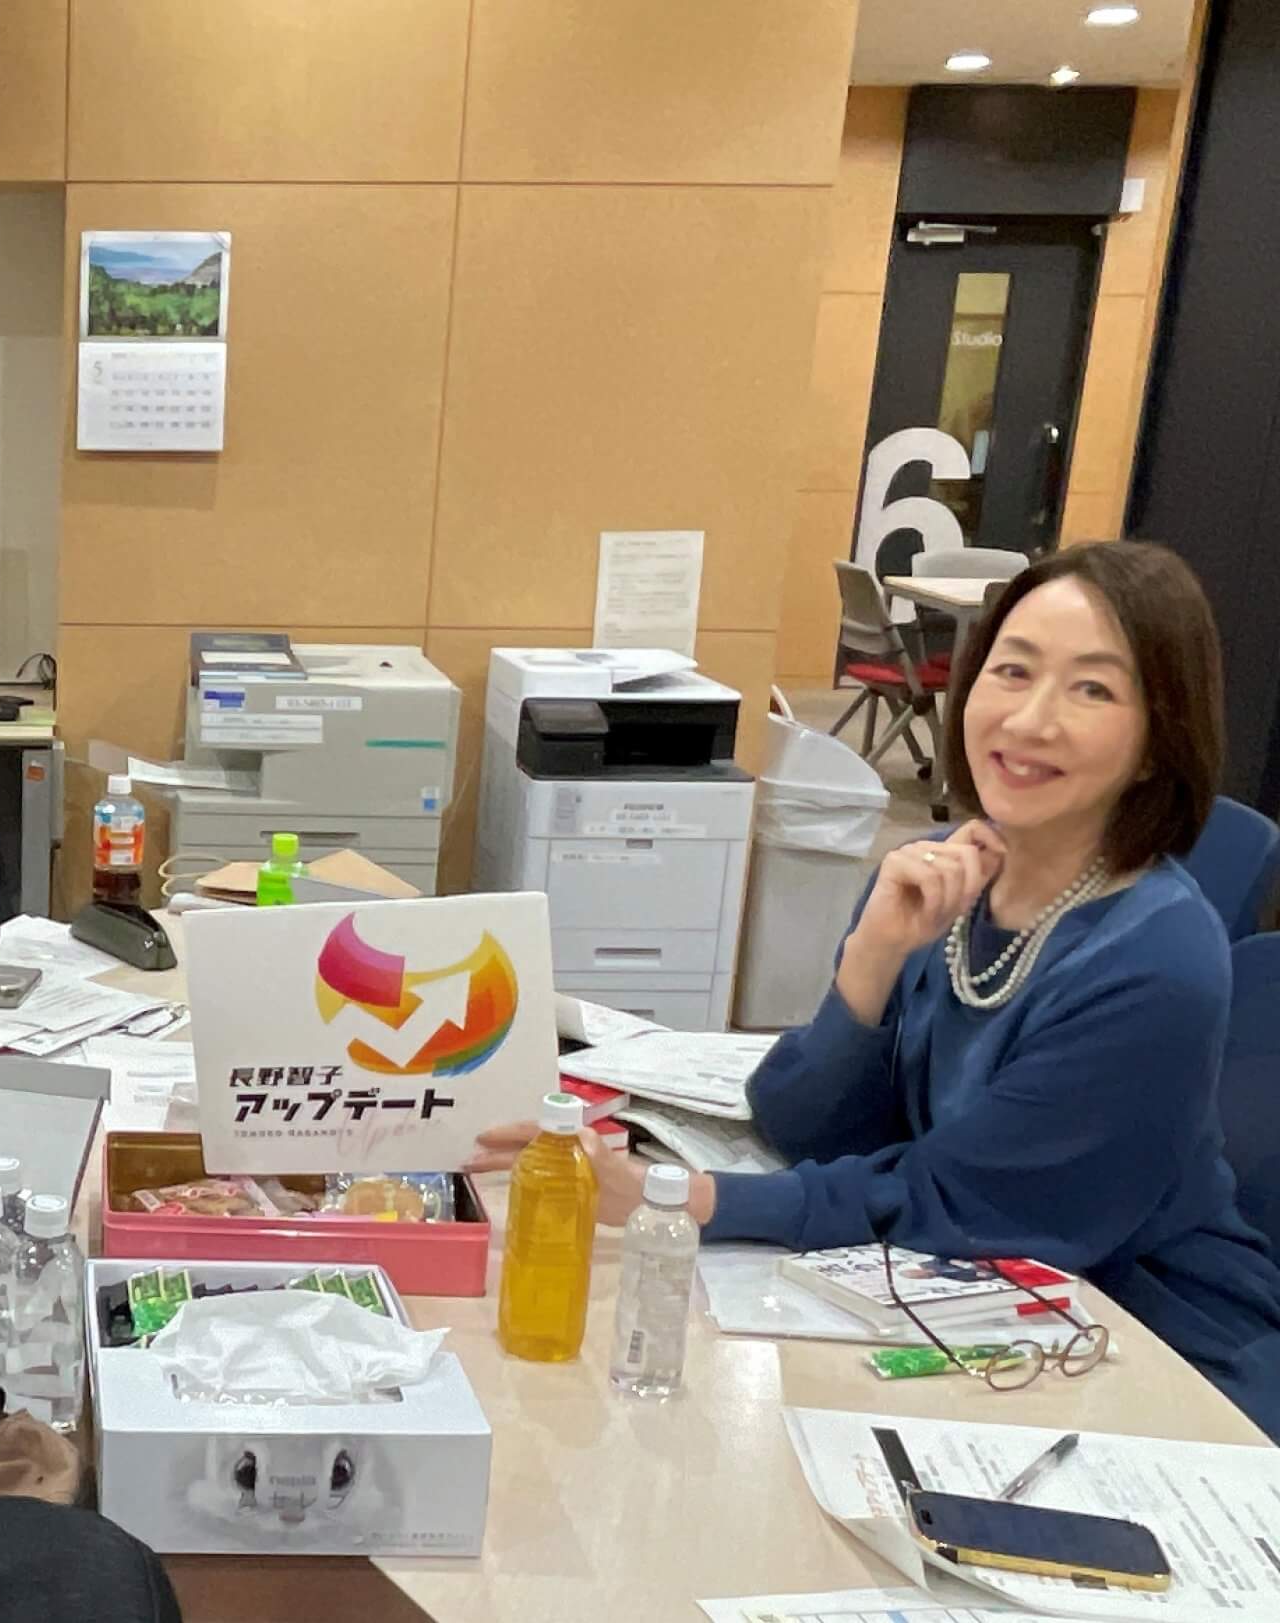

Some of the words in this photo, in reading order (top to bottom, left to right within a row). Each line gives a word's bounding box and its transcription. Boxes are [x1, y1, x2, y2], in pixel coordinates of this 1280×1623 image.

[950, 330, 1003, 347] Studio
[93, 360, 104, 379] 5
[854, 427, 971, 622] 6
[229, 1065, 343, 1087] 長野智子
[234, 1088, 455, 1122] アップデート
